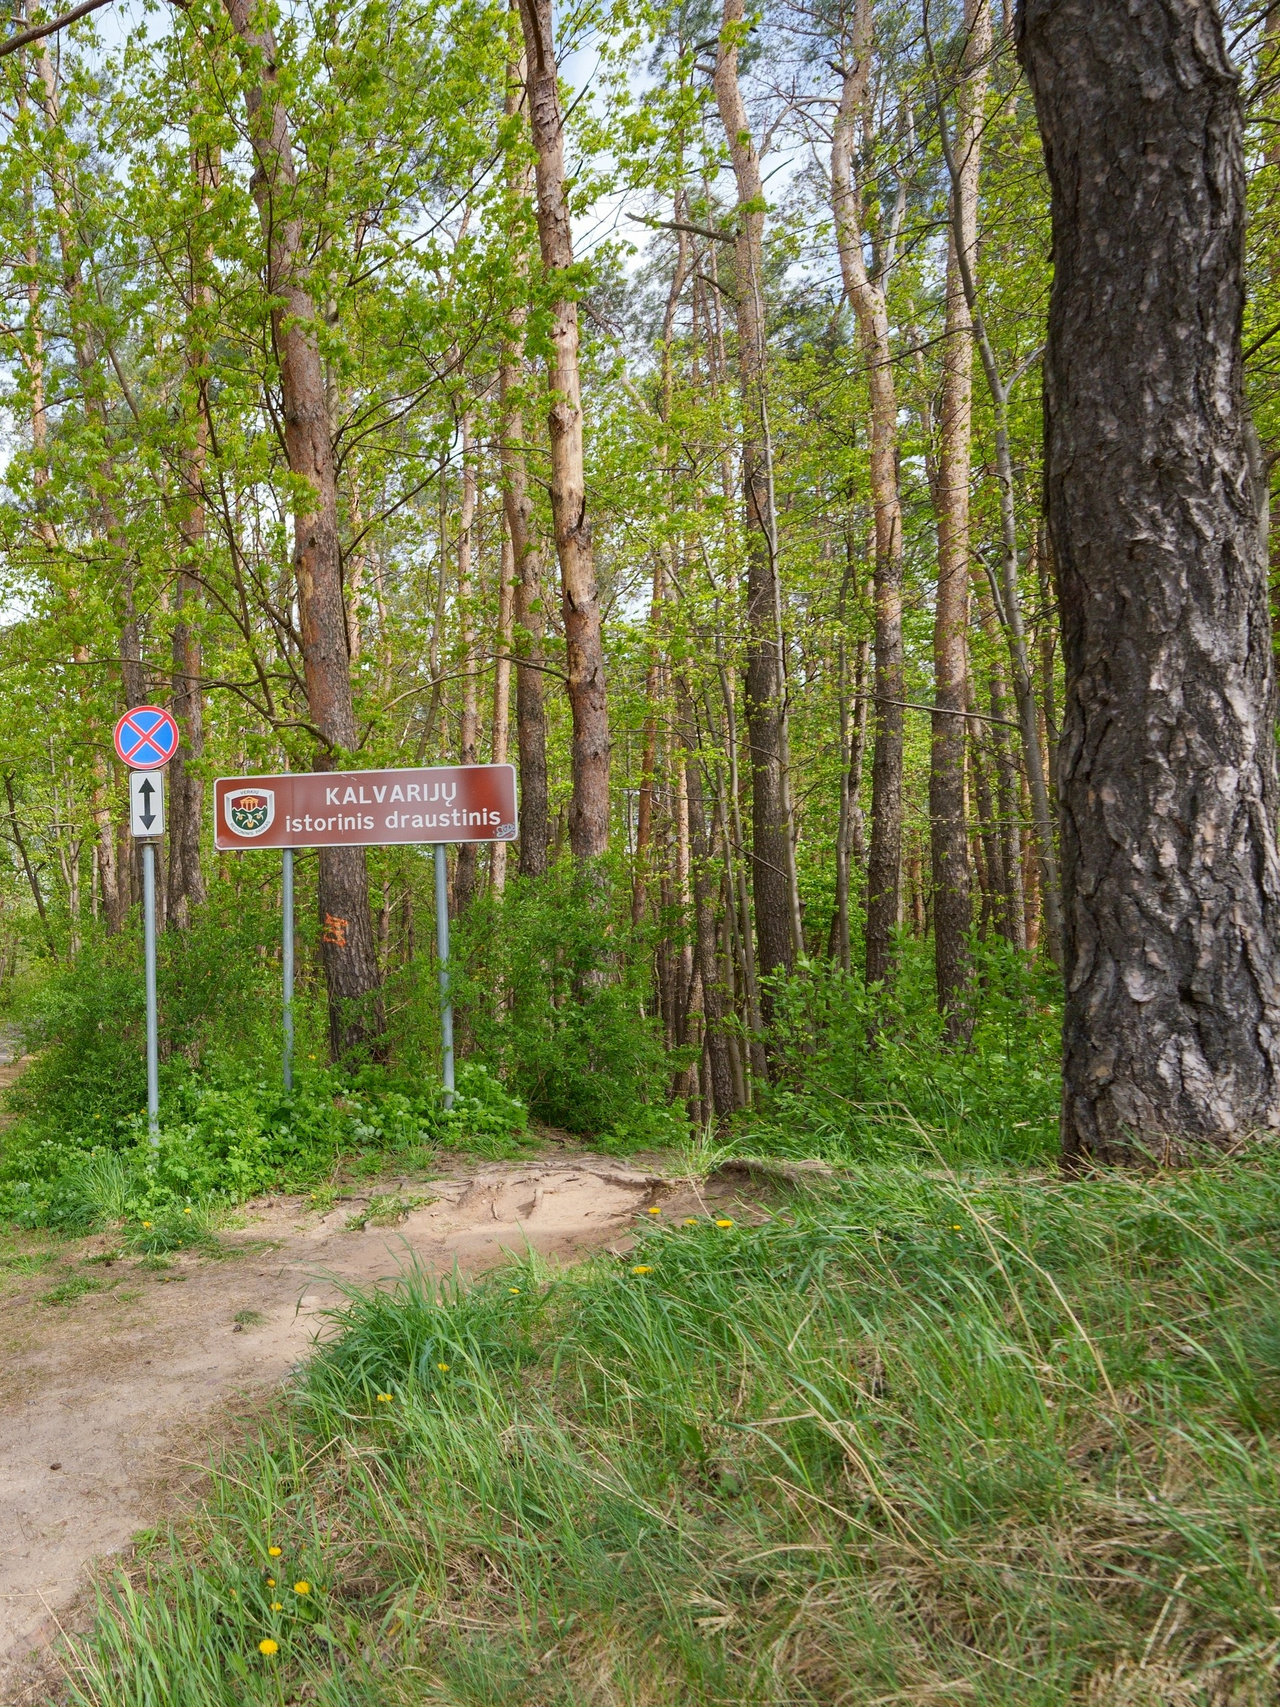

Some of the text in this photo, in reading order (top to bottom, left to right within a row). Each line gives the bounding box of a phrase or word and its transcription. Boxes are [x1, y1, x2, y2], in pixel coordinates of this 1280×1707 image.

[326, 782, 457, 807] KALVARIJŲ
[286, 808, 501, 832] istorinis draustinis
